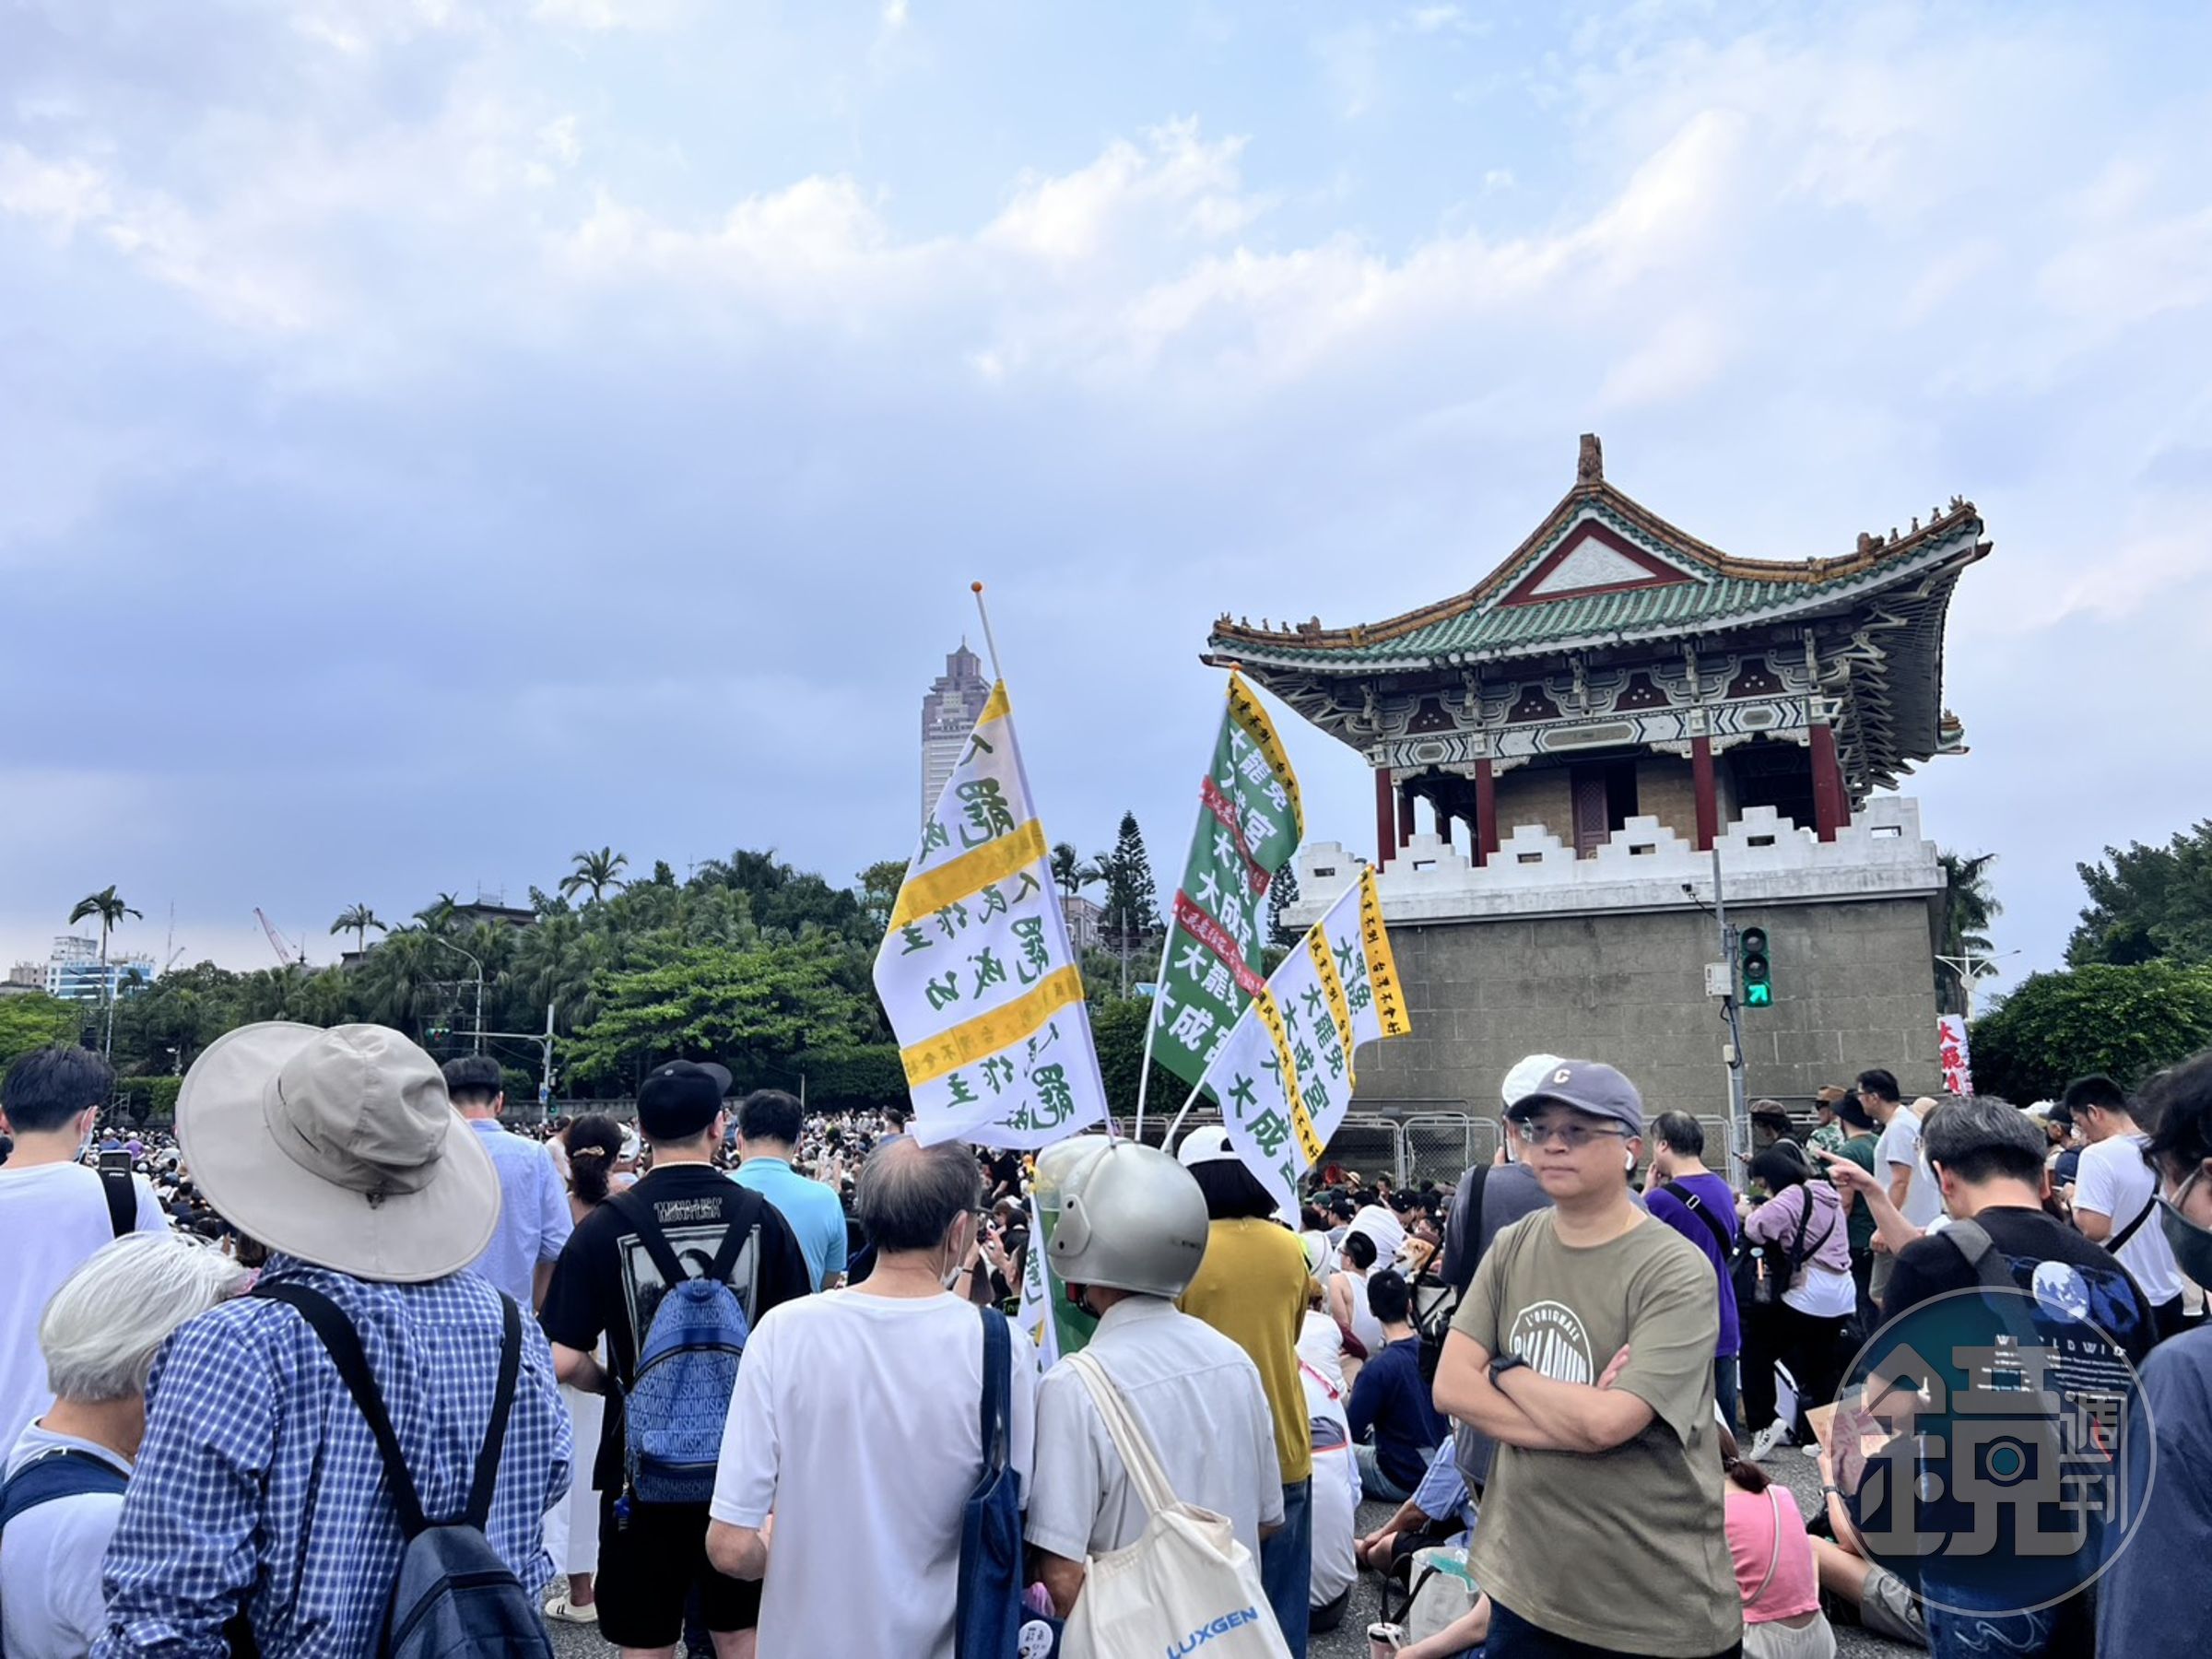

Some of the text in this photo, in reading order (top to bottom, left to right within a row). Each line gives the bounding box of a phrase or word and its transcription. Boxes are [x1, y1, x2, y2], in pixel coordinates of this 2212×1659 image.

[1230, 727, 1288, 813] 大罷免
[1300, 982, 1345, 1080] 大罷免
[1553, 1068, 1571, 1084] C
[1166, 1606, 1259, 1659] LUXGEN
